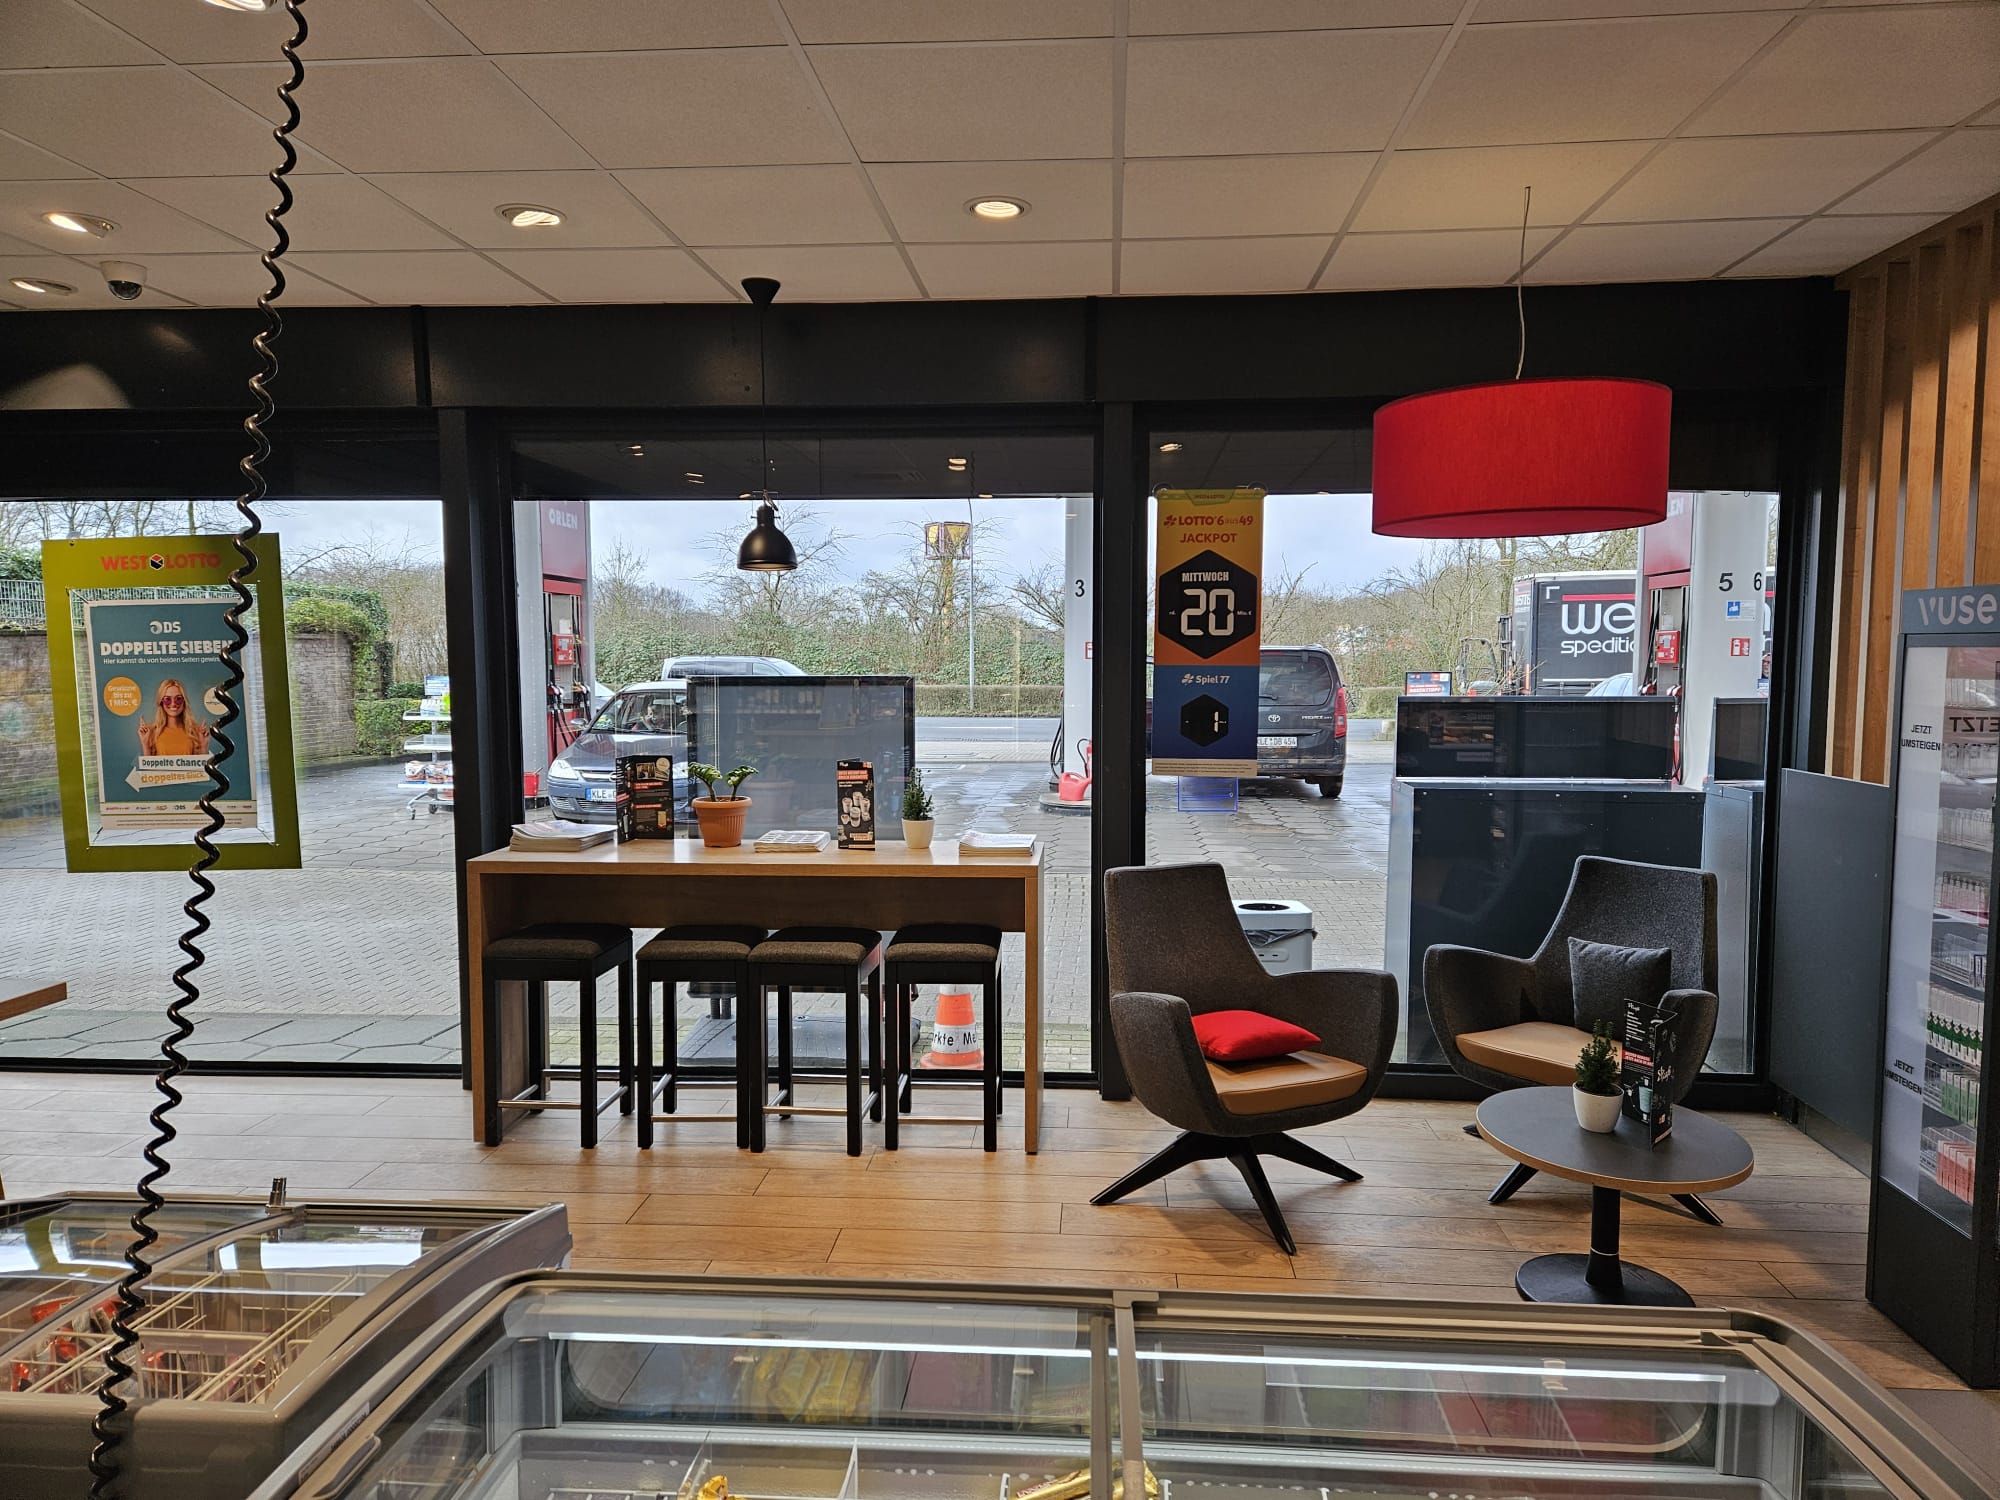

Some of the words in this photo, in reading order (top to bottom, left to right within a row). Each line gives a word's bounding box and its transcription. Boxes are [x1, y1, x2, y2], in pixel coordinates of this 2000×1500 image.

[549, 509, 578, 529] ORLEN
[1180, 533, 1238, 543] JACKPOT
[101, 555, 148, 571] WEST
[165, 553, 221, 569] LOTTO
[1182, 571, 1229, 582] MITTWOCH
[1719, 572, 1733, 591] 5
[1754, 572, 1762, 591] 6
[1075, 579, 1085, 597] 3
[1180, 588, 1235, 636] 20
[1562, 603, 1636, 635] we
[100, 641, 178, 656] DOPPELTE
[117, 656, 137, 664] kannst
[138, 656, 145, 664] du
[160, 655, 180, 663] beiden
[180, 655, 200, 663] Seiten
[1196, 675, 1218, 685] Spiel
[1220, 675, 1230, 683] 77
[1911, 724, 1933, 735] JETZT
[1901, 738, 1941, 751] UMSTEIGEN
[142, 758, 174, 768] Doppelte
[592, 789, 607, 799] KLE
[933, 1031, 954, 1046] rkte
[1894, 1059, 1914, 1075] JETZT
[1884, 1068, 1922, 1095] UMSTEIGEN
